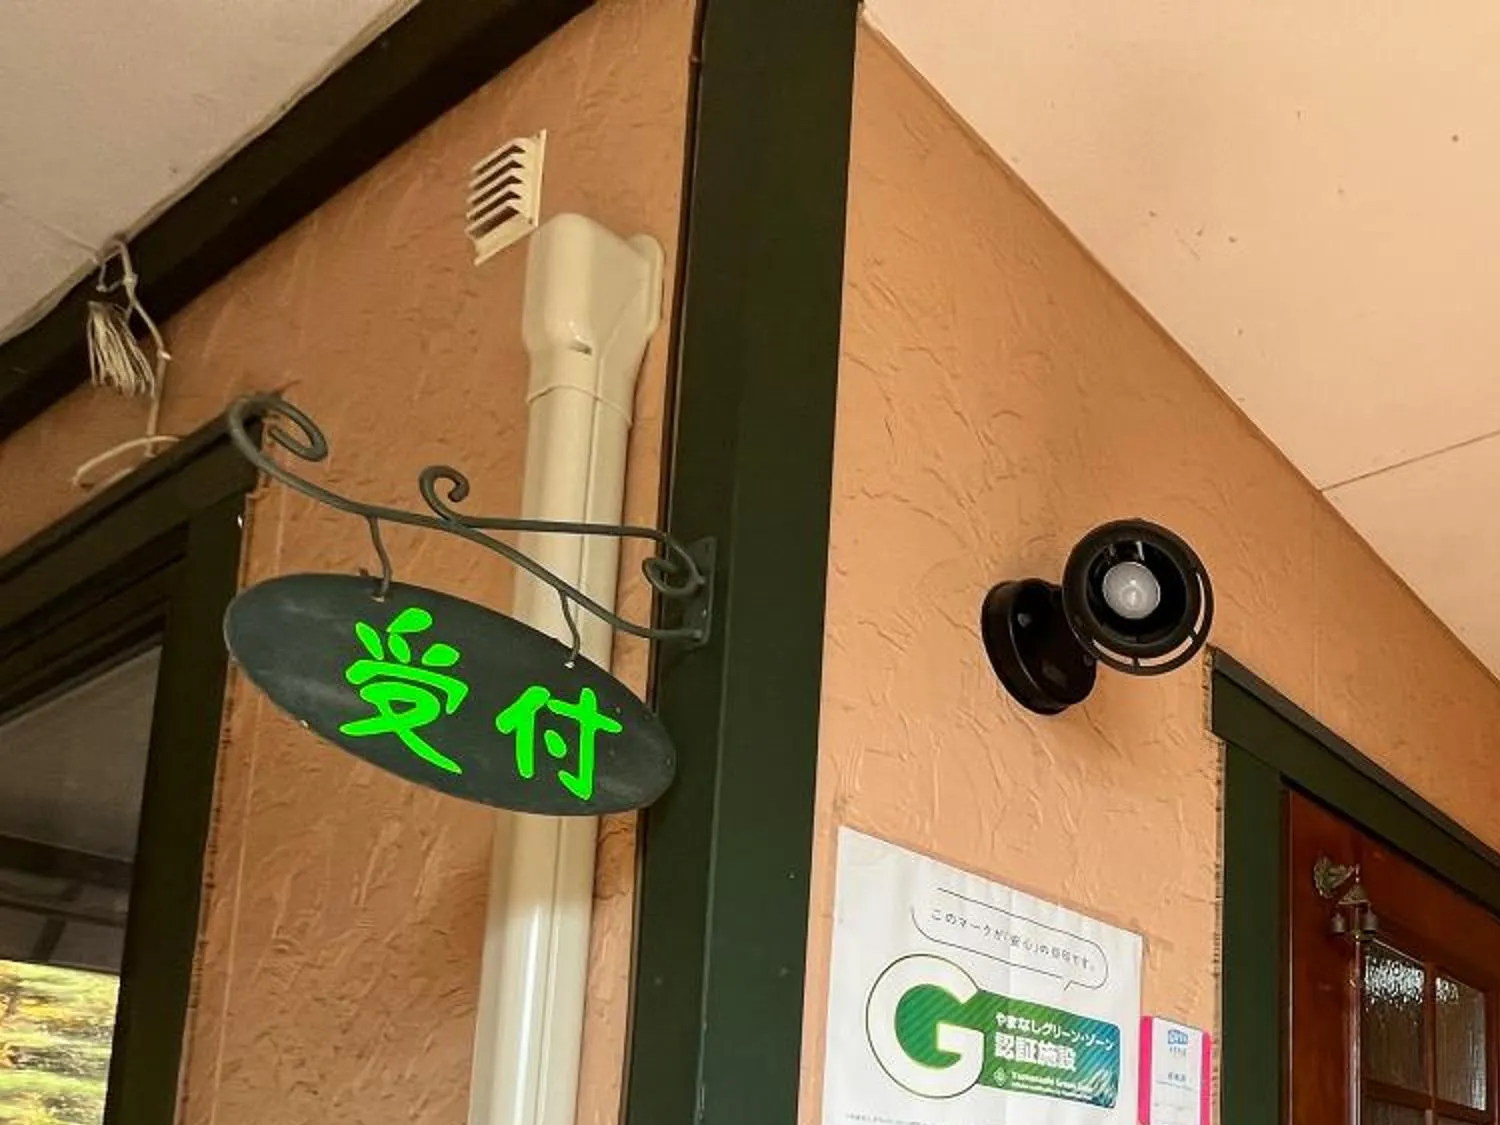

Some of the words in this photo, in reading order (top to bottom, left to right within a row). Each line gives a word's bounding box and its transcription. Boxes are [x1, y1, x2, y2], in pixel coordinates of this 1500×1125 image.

[340, 607, 623, 800] 受付
[995, 1032, 1076, 1072] 認証施設
